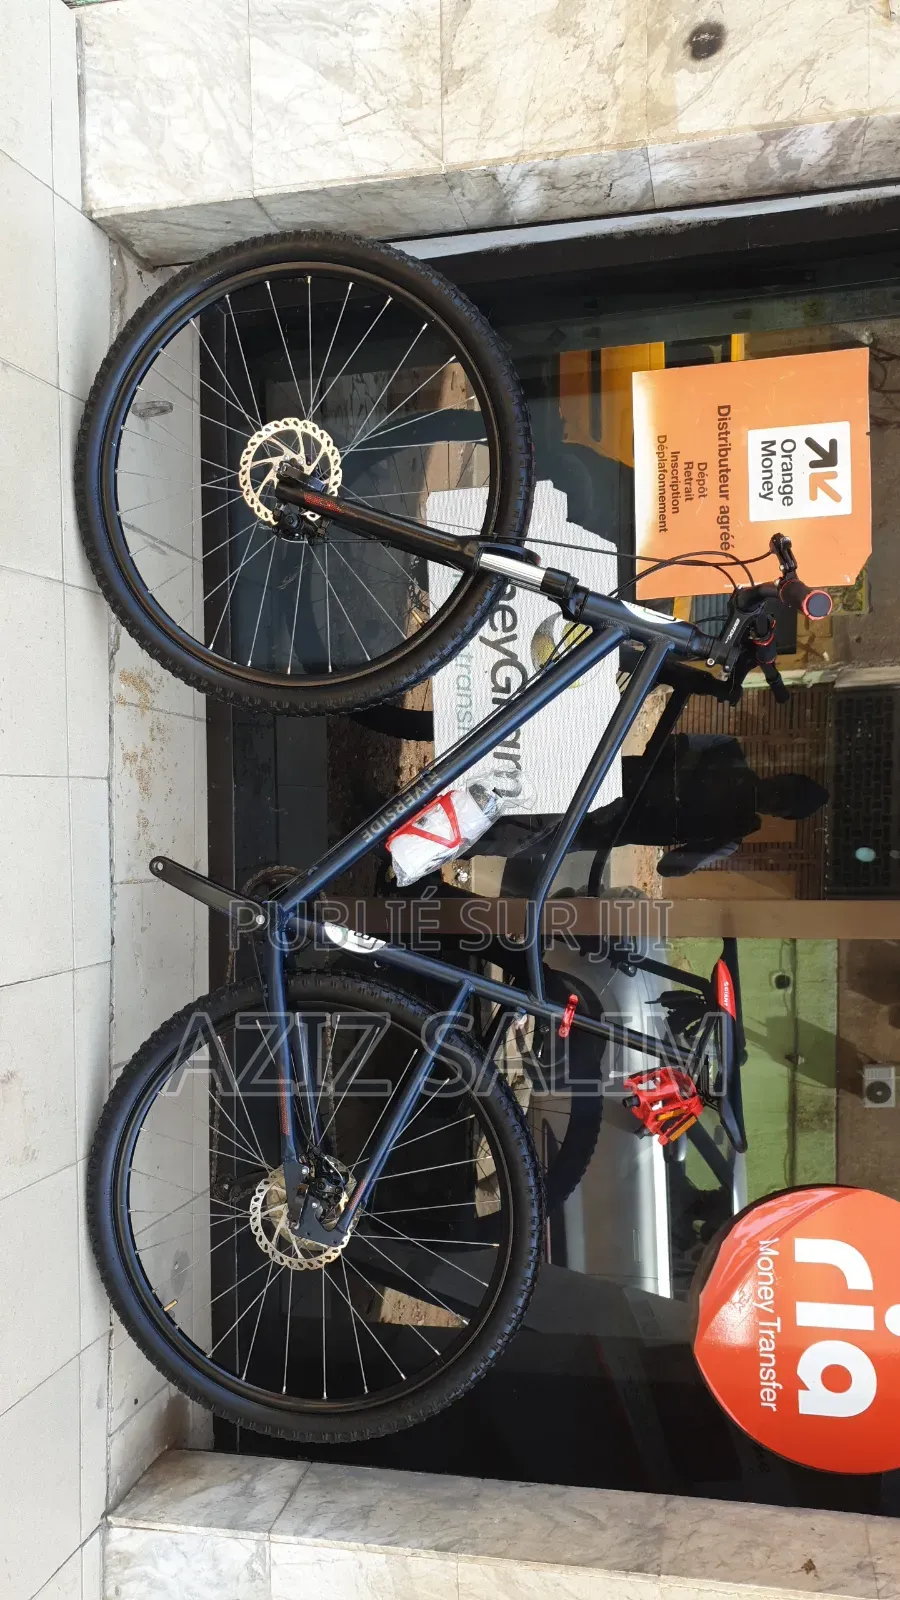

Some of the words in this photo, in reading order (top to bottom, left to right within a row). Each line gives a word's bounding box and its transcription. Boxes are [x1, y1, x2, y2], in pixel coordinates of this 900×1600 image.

[656, 434, 668, 532] Déplafonnement
[668, 451, 681, 514] Inscription
[684, 461, 694, 502] Retrait
[696, 462, 708, 498] Dépôt
[717, 404, 732, 500] Distributeur
[758, 440, 776, 502] Money
[778, 438, 796, 507] Orange
[716, 505, 734, 550] agréé
[359, 770, 442, 843] RIVERSIDE
[754, 1238, 780, 1312] Money
[795, 1238, 900, 1417] ria
[759, 1317, 782, 1412] Transfer
